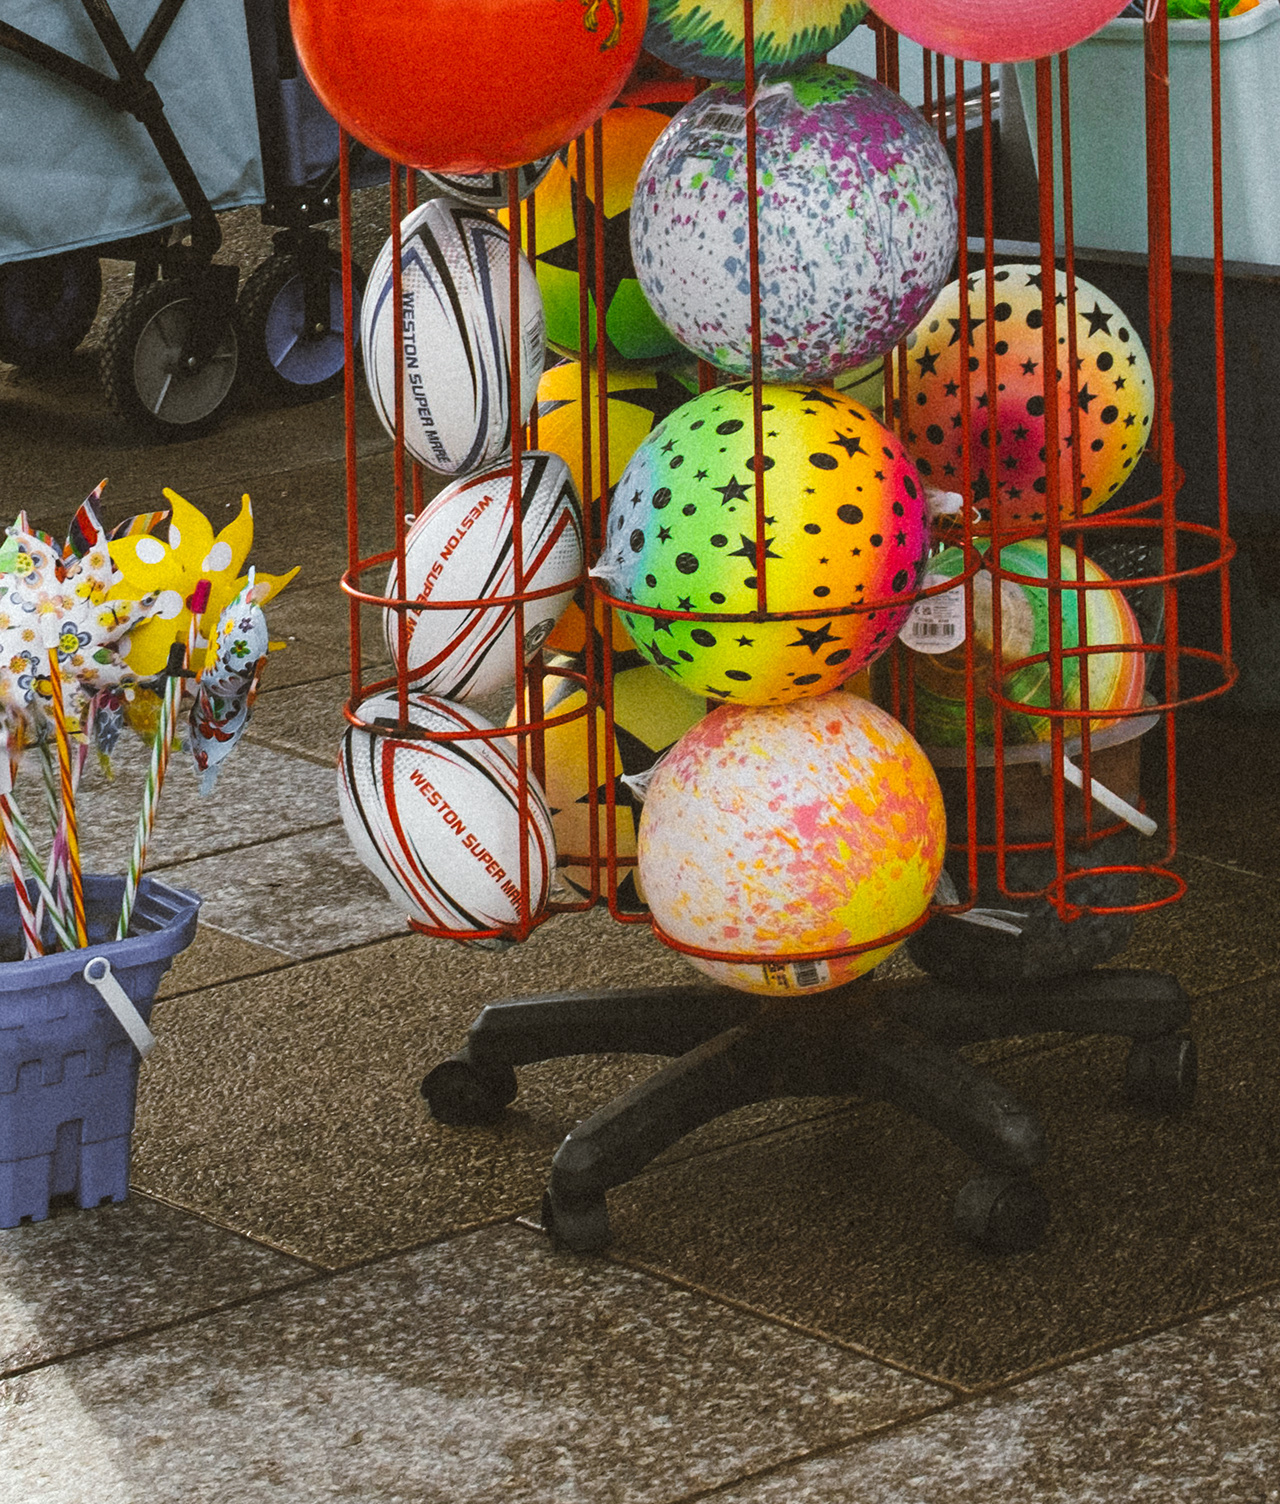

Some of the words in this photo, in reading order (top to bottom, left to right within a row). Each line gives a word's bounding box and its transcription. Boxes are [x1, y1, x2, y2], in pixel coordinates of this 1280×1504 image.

[403, 290, 420, 369] WESTON
[408, 372, 435, 432] SUPER
[440, 495, 494, 561] WESTON
[409, 768, 467, 836] WESTON
[461, 832, 508, 884] SUPER
